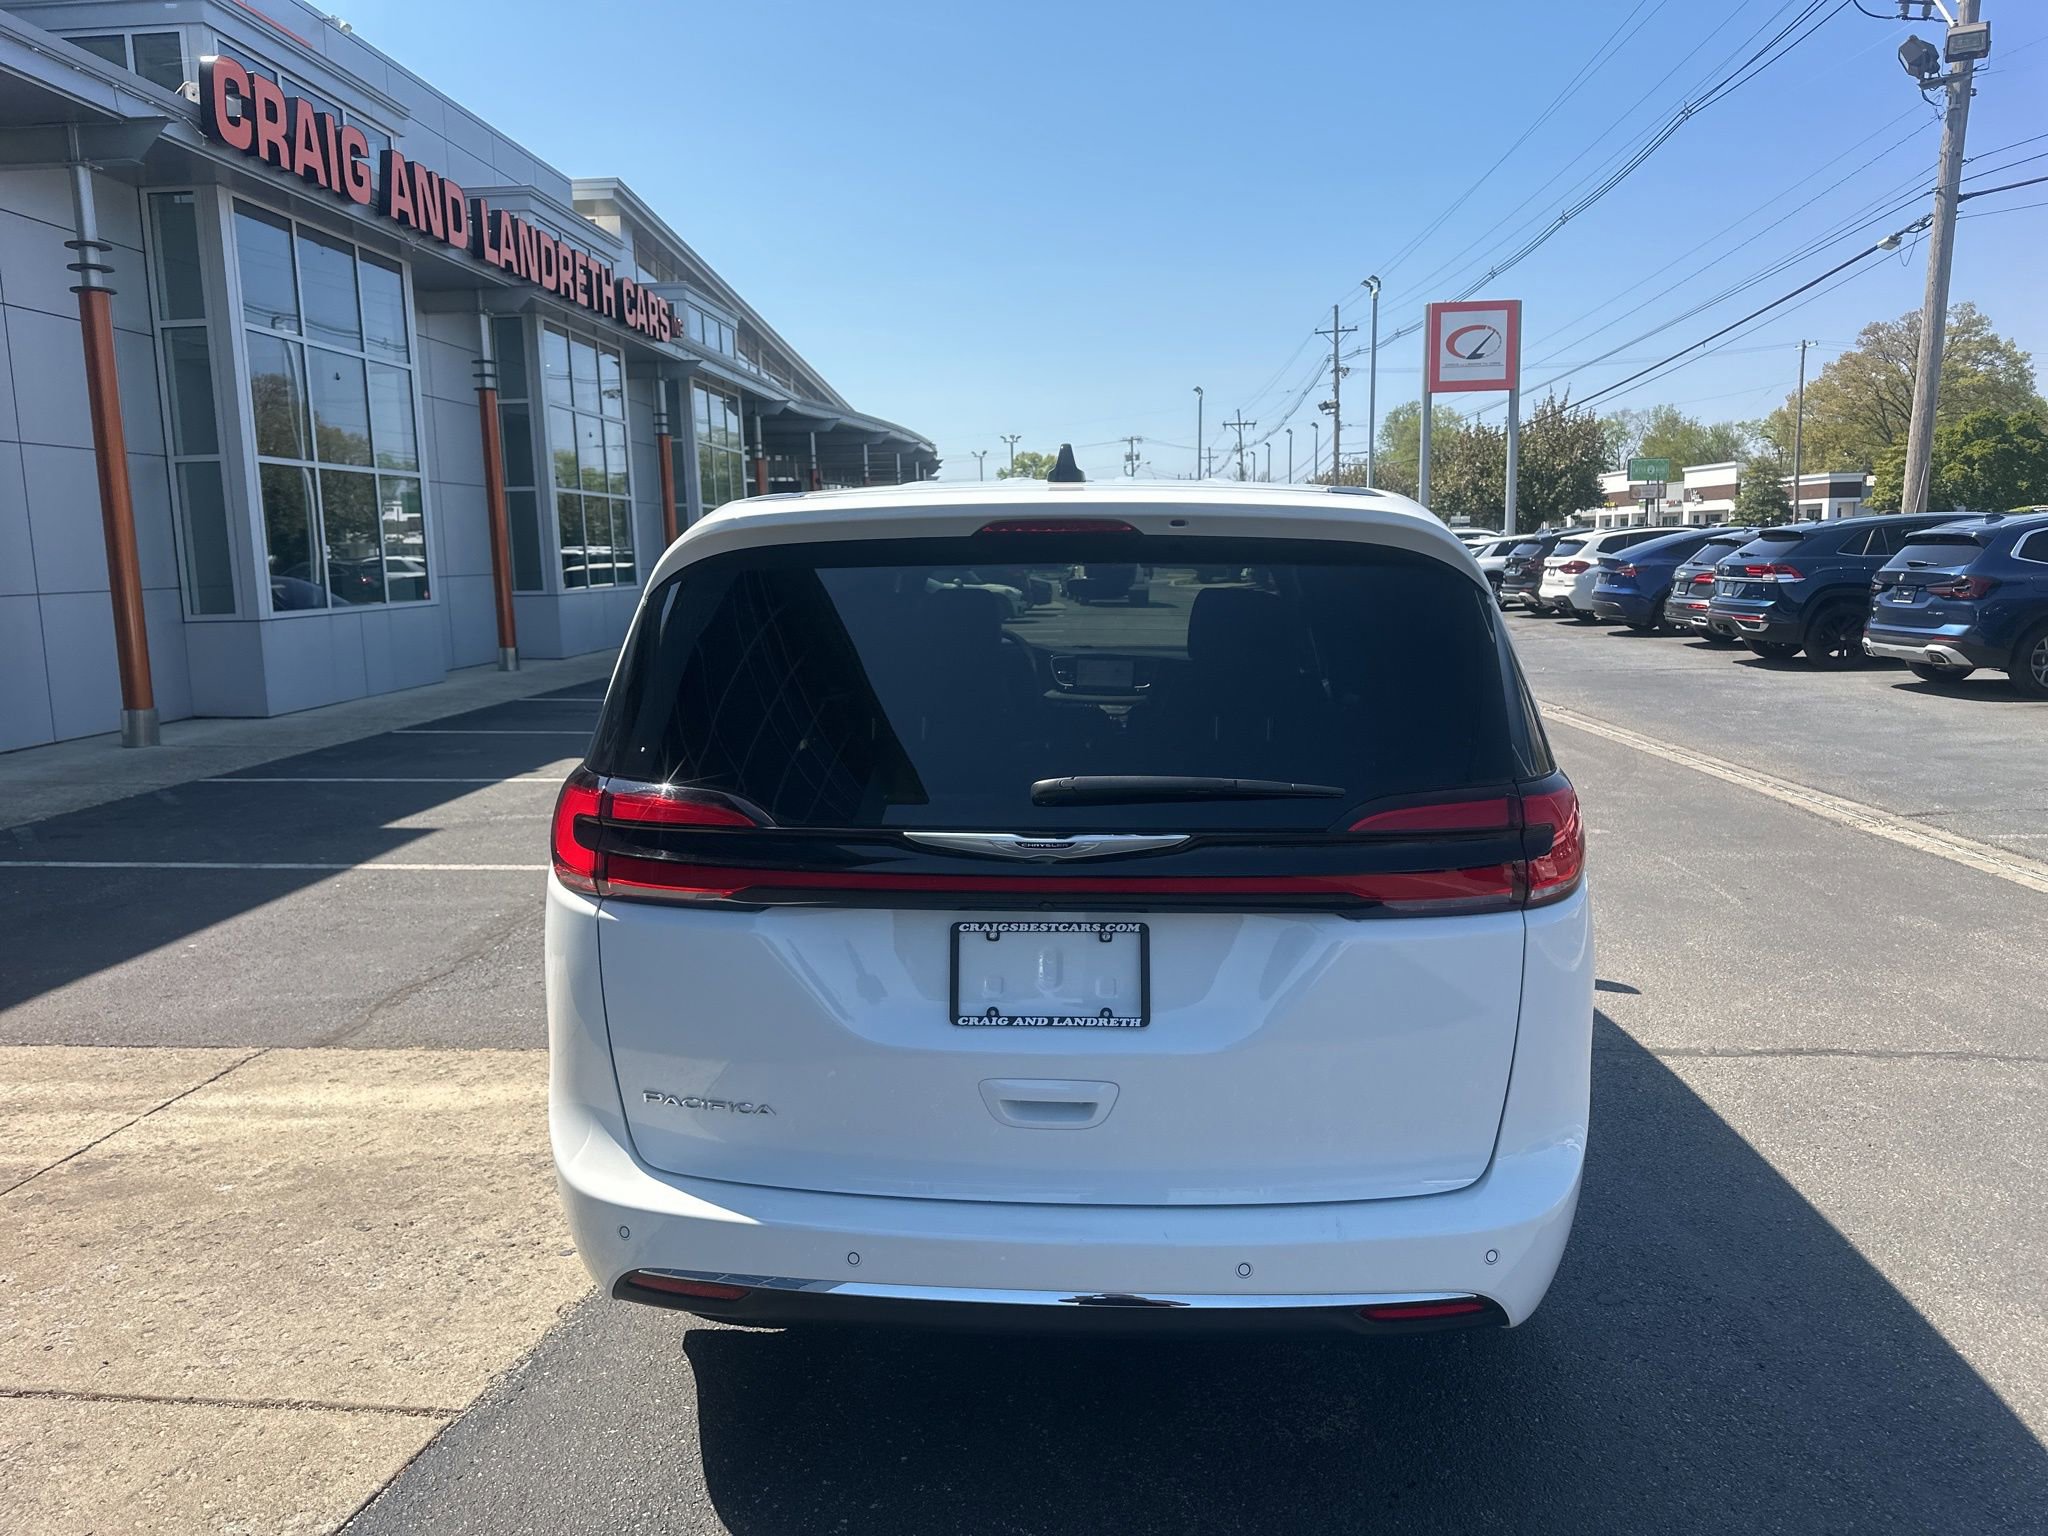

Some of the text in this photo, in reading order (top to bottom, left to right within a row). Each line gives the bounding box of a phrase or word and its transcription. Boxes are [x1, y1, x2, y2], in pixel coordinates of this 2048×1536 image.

[212, 55, 373, 206] CRAIG
[390, 149, 468, 250] AND
[480, 197, 617, 320] LANDRETH
[622, 276, 671, 343] CARS
[958, 923, 1141, 933] CRAIGSBESTCARS.COM
[957, 1016, 1142, 1027] CRAIG AND LANDRETH
[642, 1089, 777, 1116] PACIFICA
